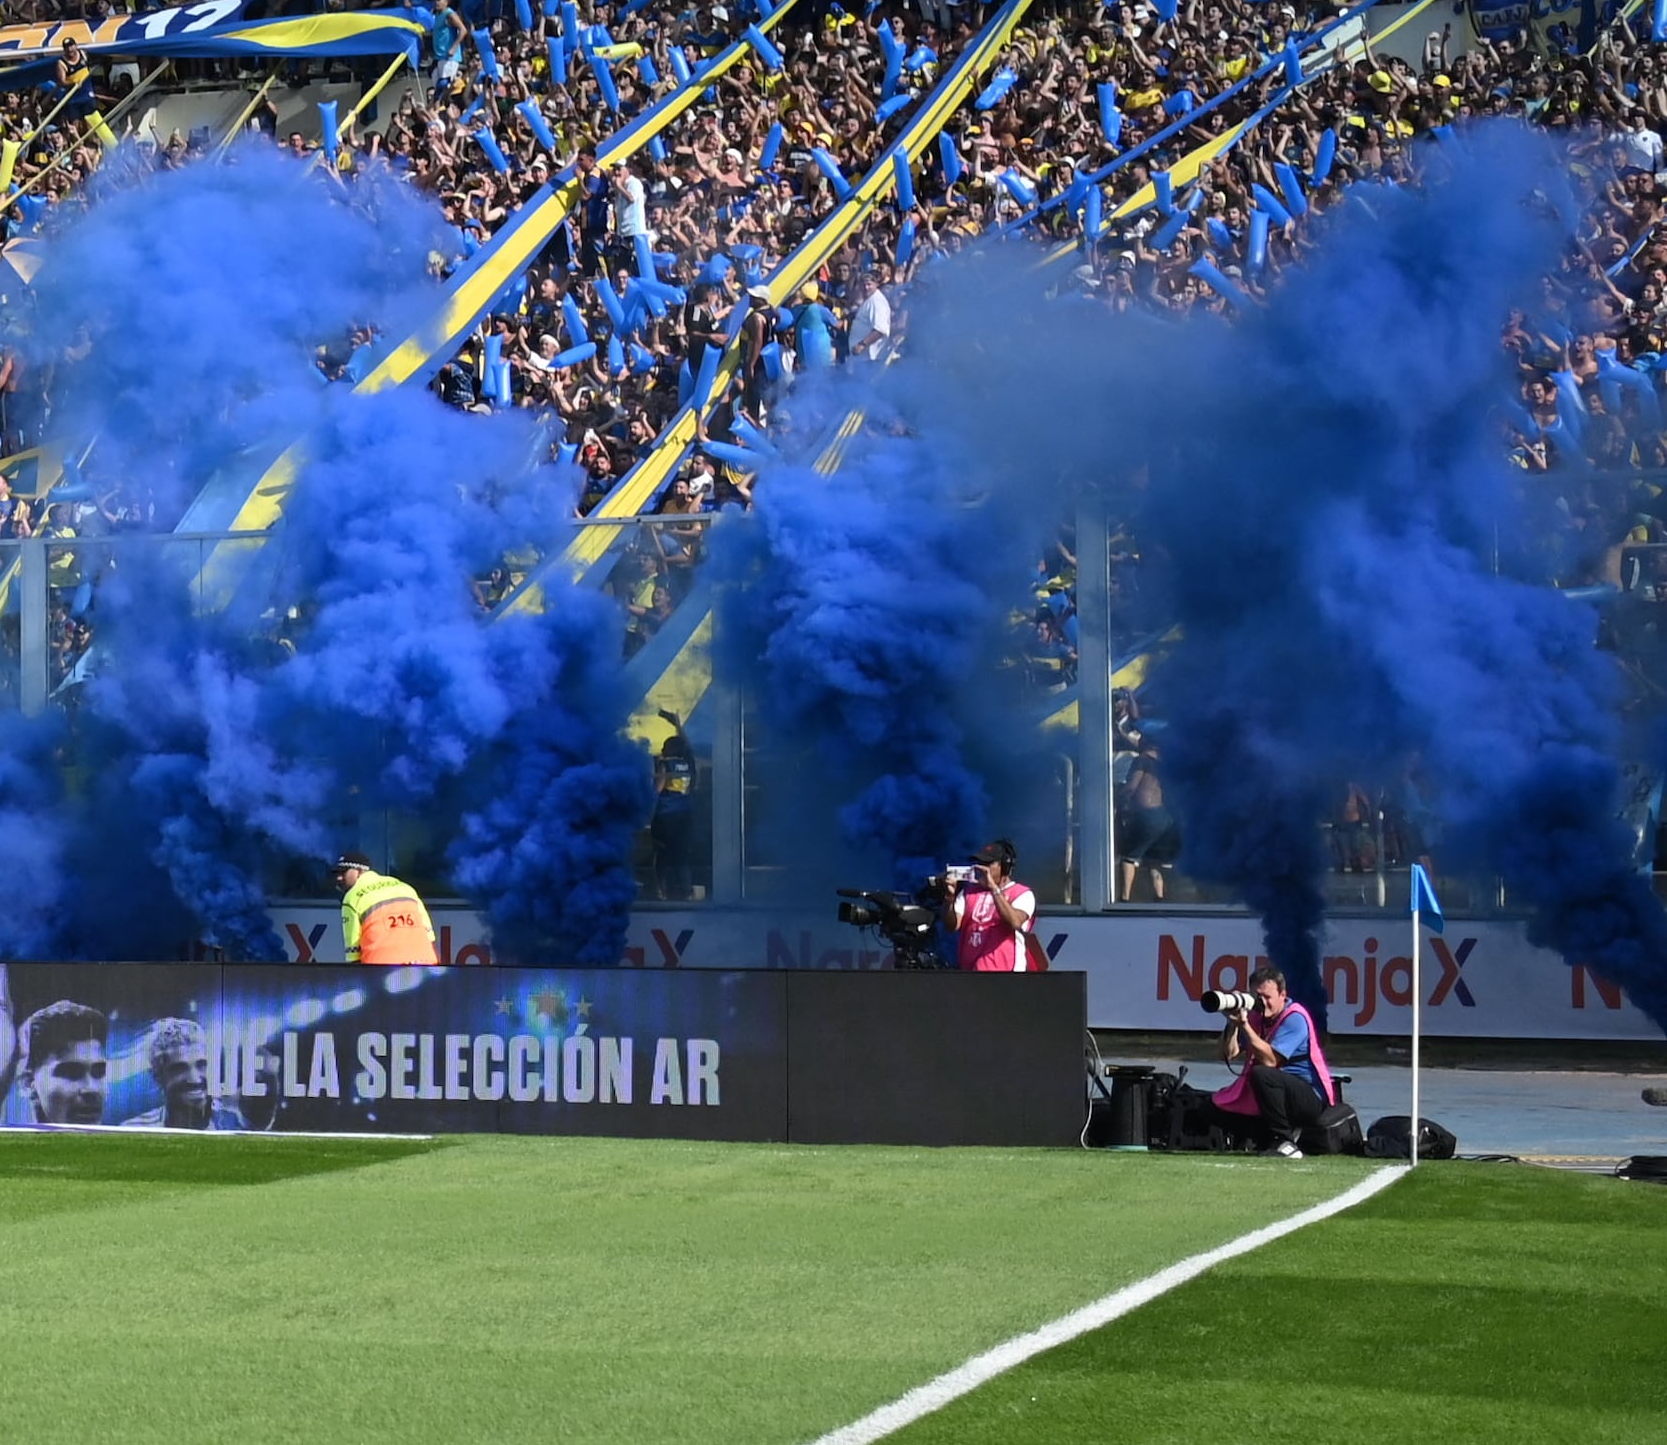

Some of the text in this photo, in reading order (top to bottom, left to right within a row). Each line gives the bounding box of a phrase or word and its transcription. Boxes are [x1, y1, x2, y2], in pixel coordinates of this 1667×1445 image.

[283, 1031, 340, 1099] LA
[356, 1024, 633, 1105] SELECCIÓN
[650, 1038, 722, 1107] AR
